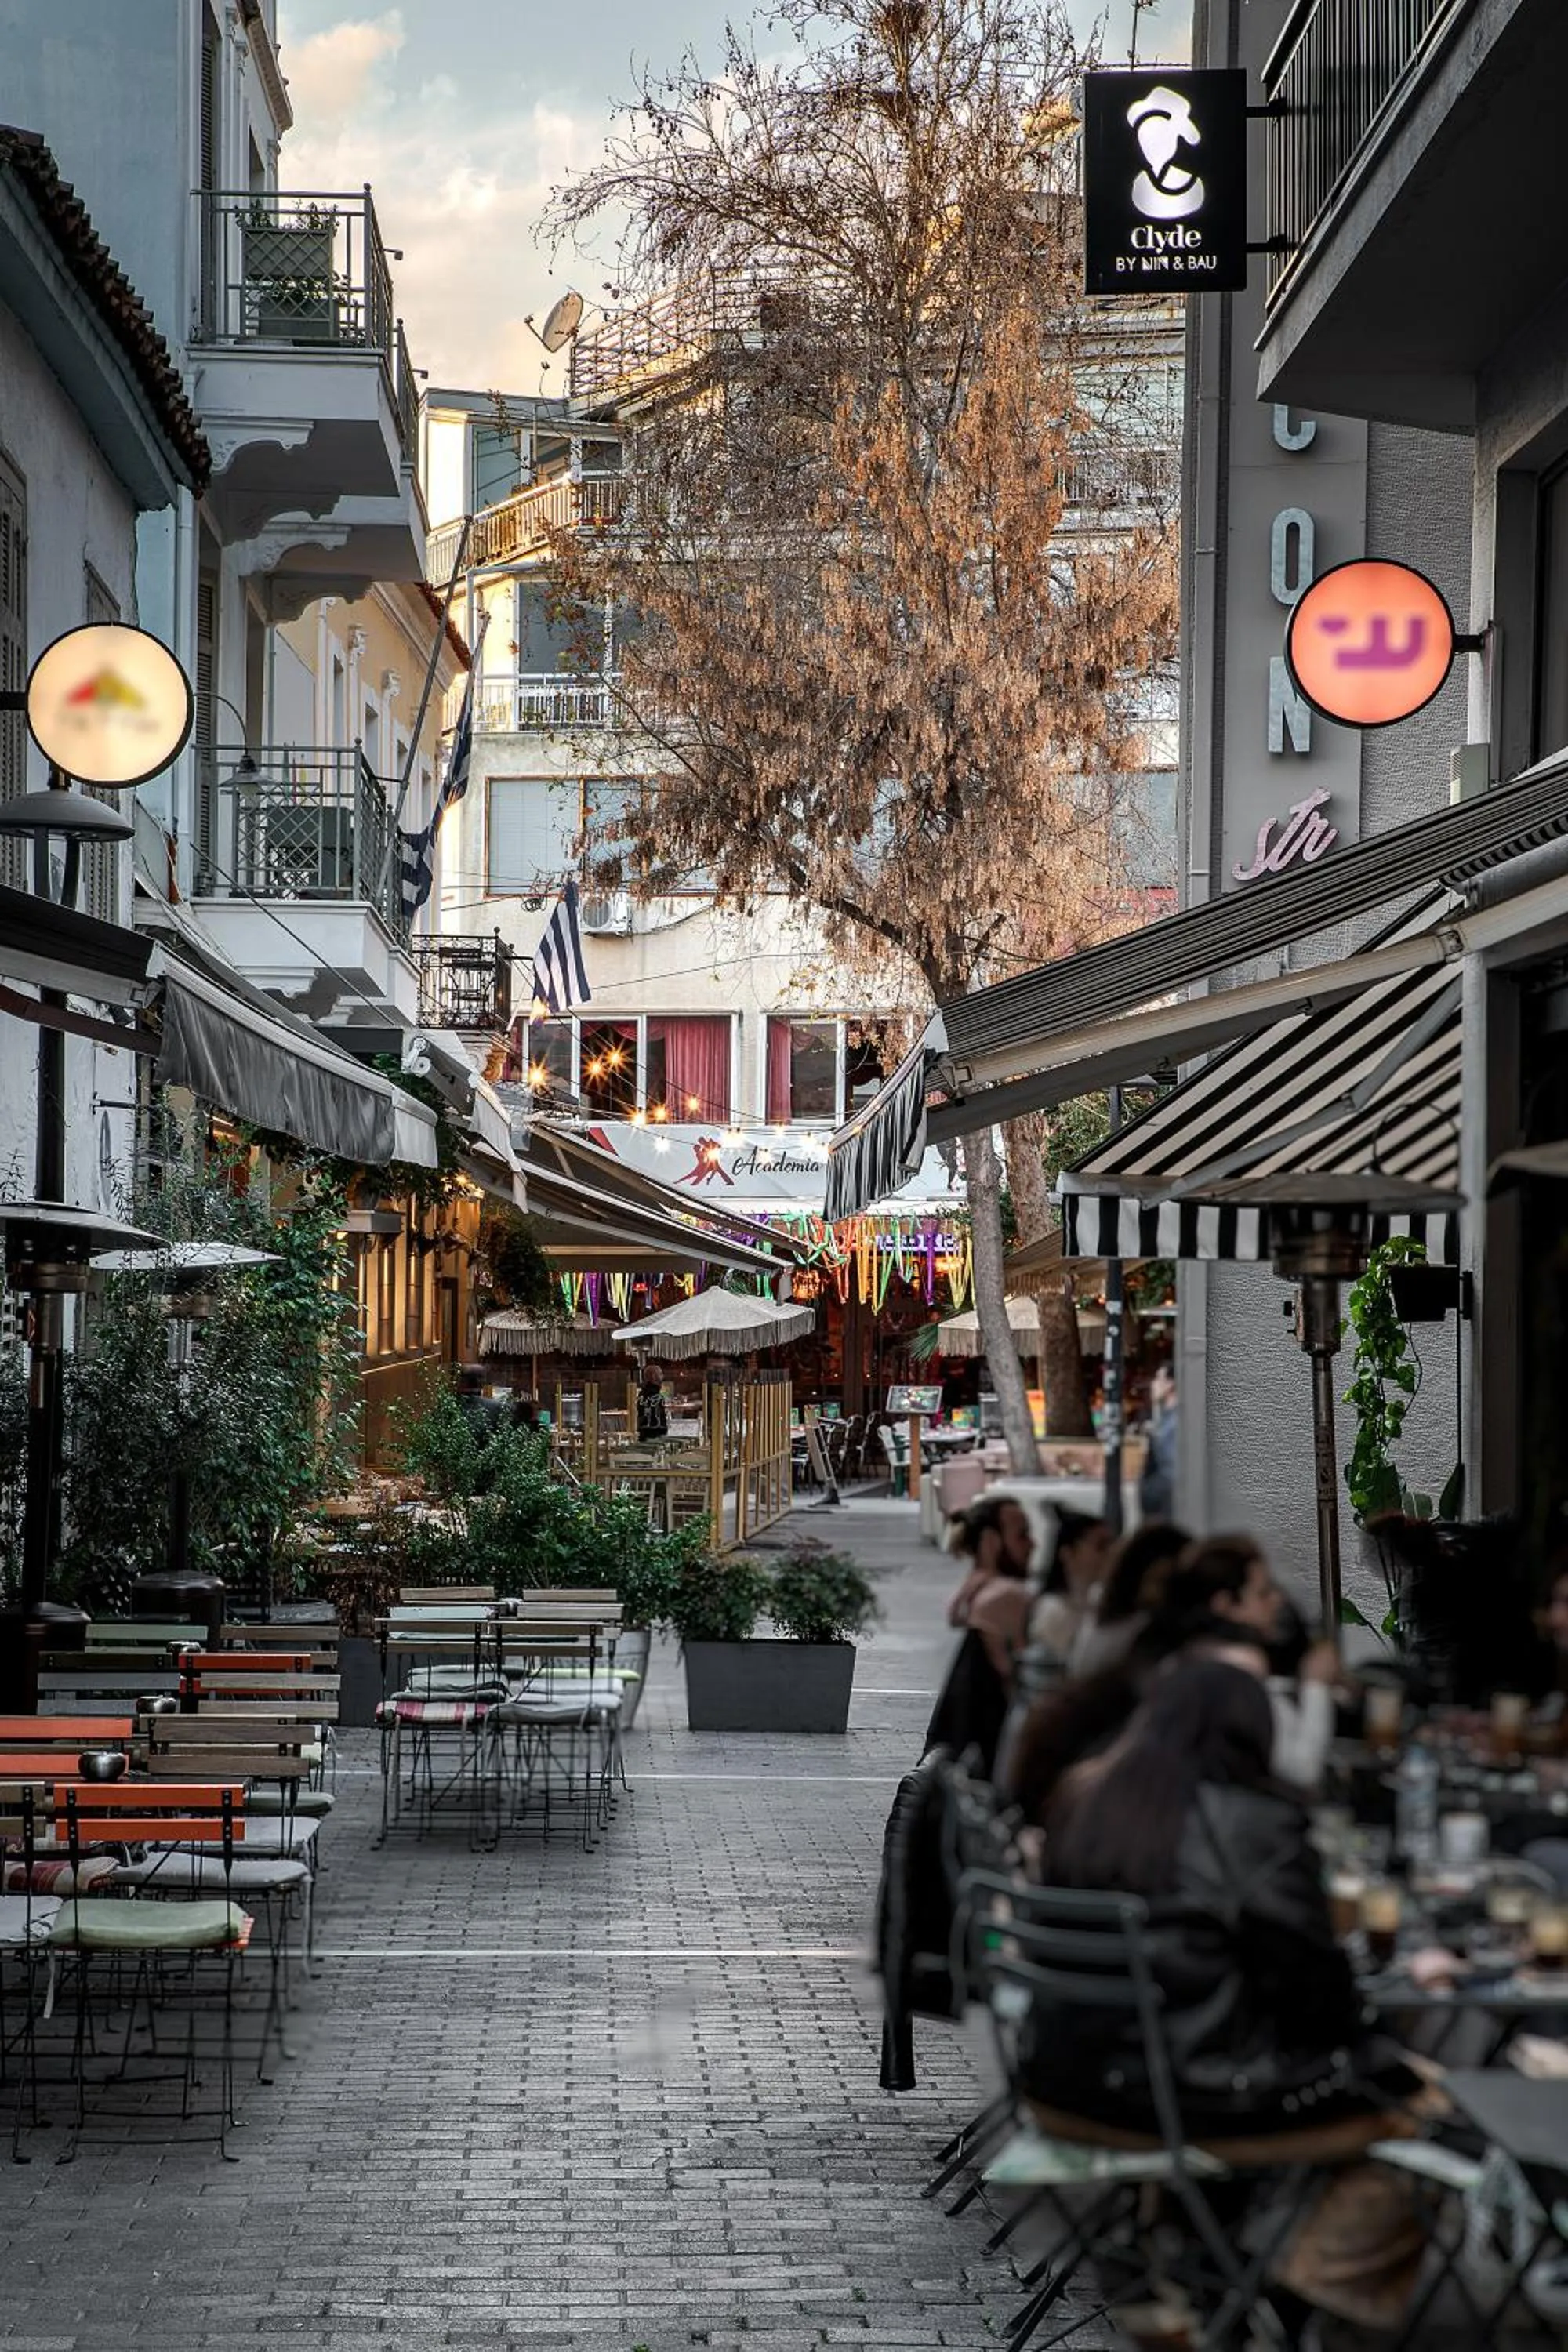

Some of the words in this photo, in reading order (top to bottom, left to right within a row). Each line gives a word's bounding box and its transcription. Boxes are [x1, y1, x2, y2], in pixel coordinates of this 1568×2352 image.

[1131, 223, 1202, 255] Clyde
[1116, 256, 1136, 272] BY
[1173, 255, 1185, 270] &
[1188, 254, 1217, 270] BAU
[731, 1145, 819, 1176] Academia
